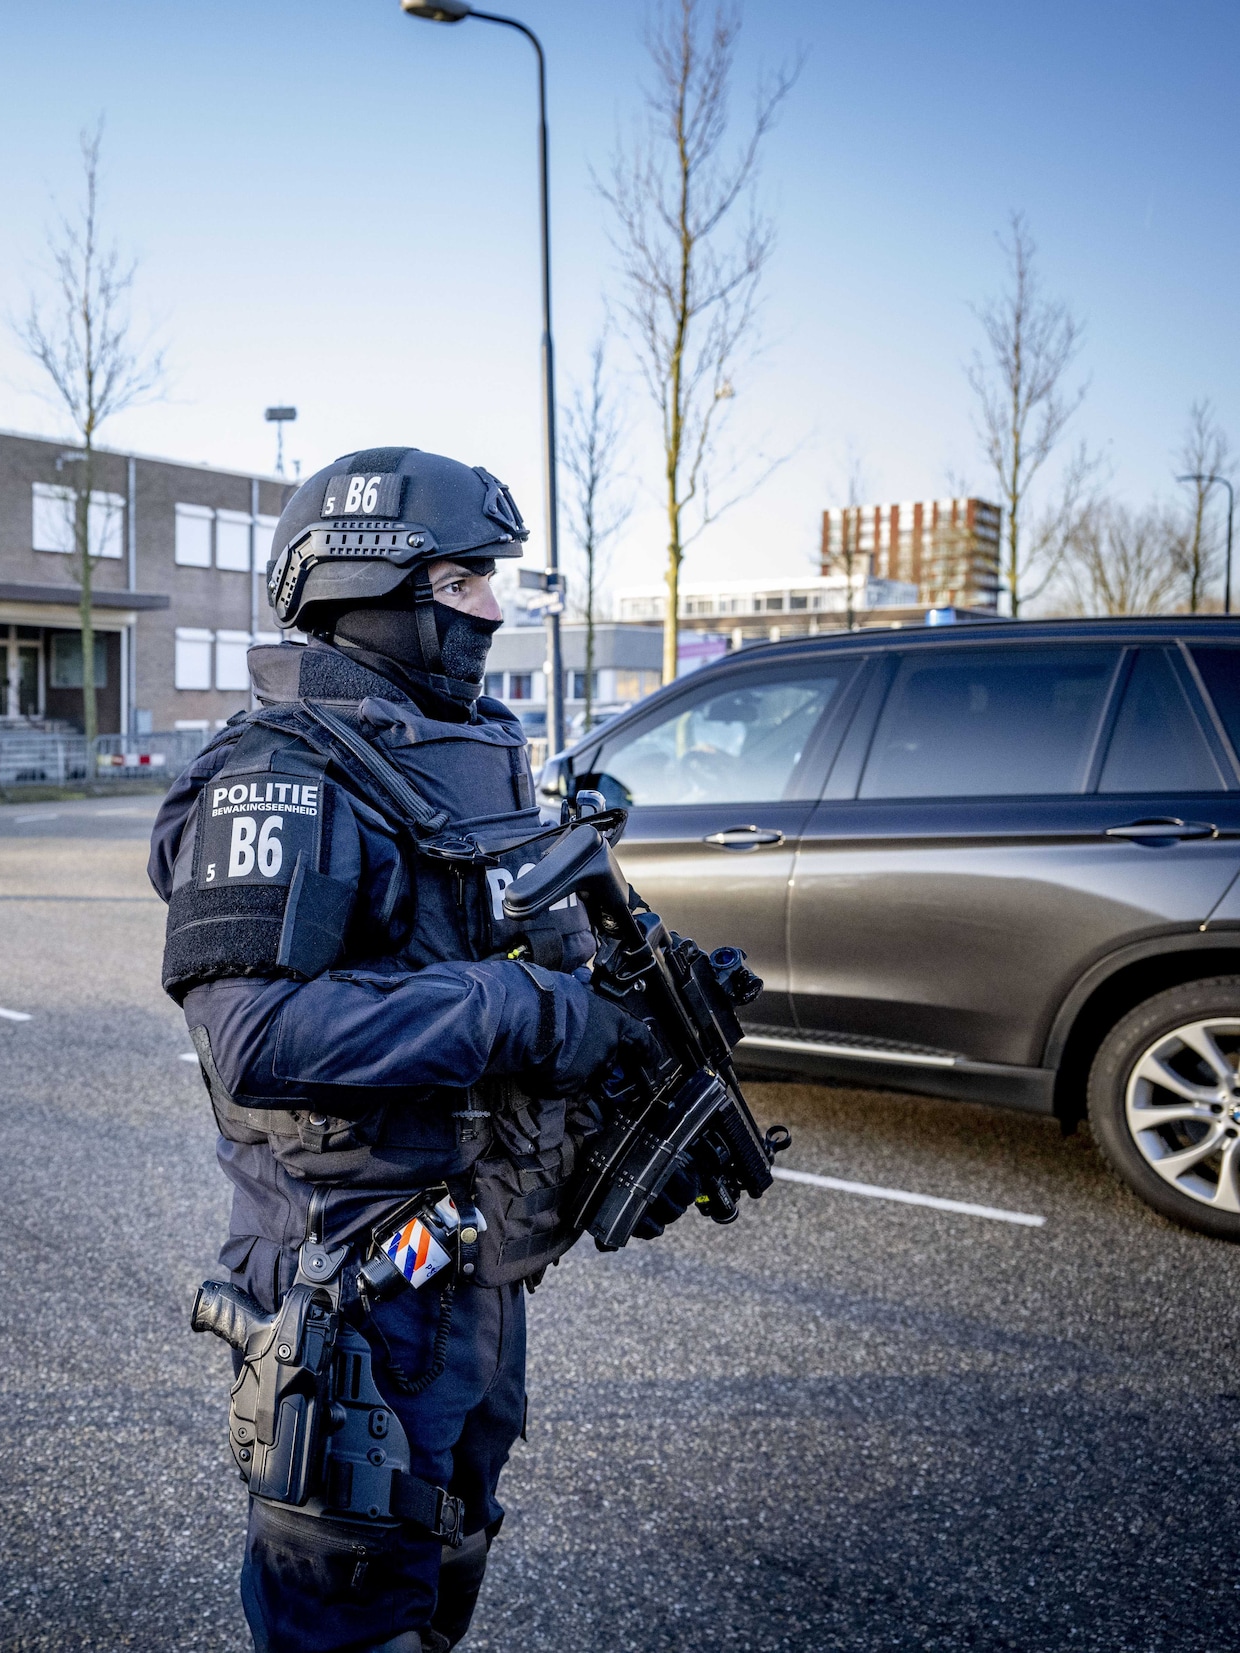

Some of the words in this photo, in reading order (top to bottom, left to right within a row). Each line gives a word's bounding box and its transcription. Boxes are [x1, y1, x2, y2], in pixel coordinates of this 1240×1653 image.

[325, 497, 336, 515] 5
[344, 476, 381, 513] B6
[212, 783, 318, 808] POLITIE
[212, 803, 317, 817] BEWAKINGSEENHEID
[206, 863, 216, 882] 5
[228, 815, 283, 877] B6
